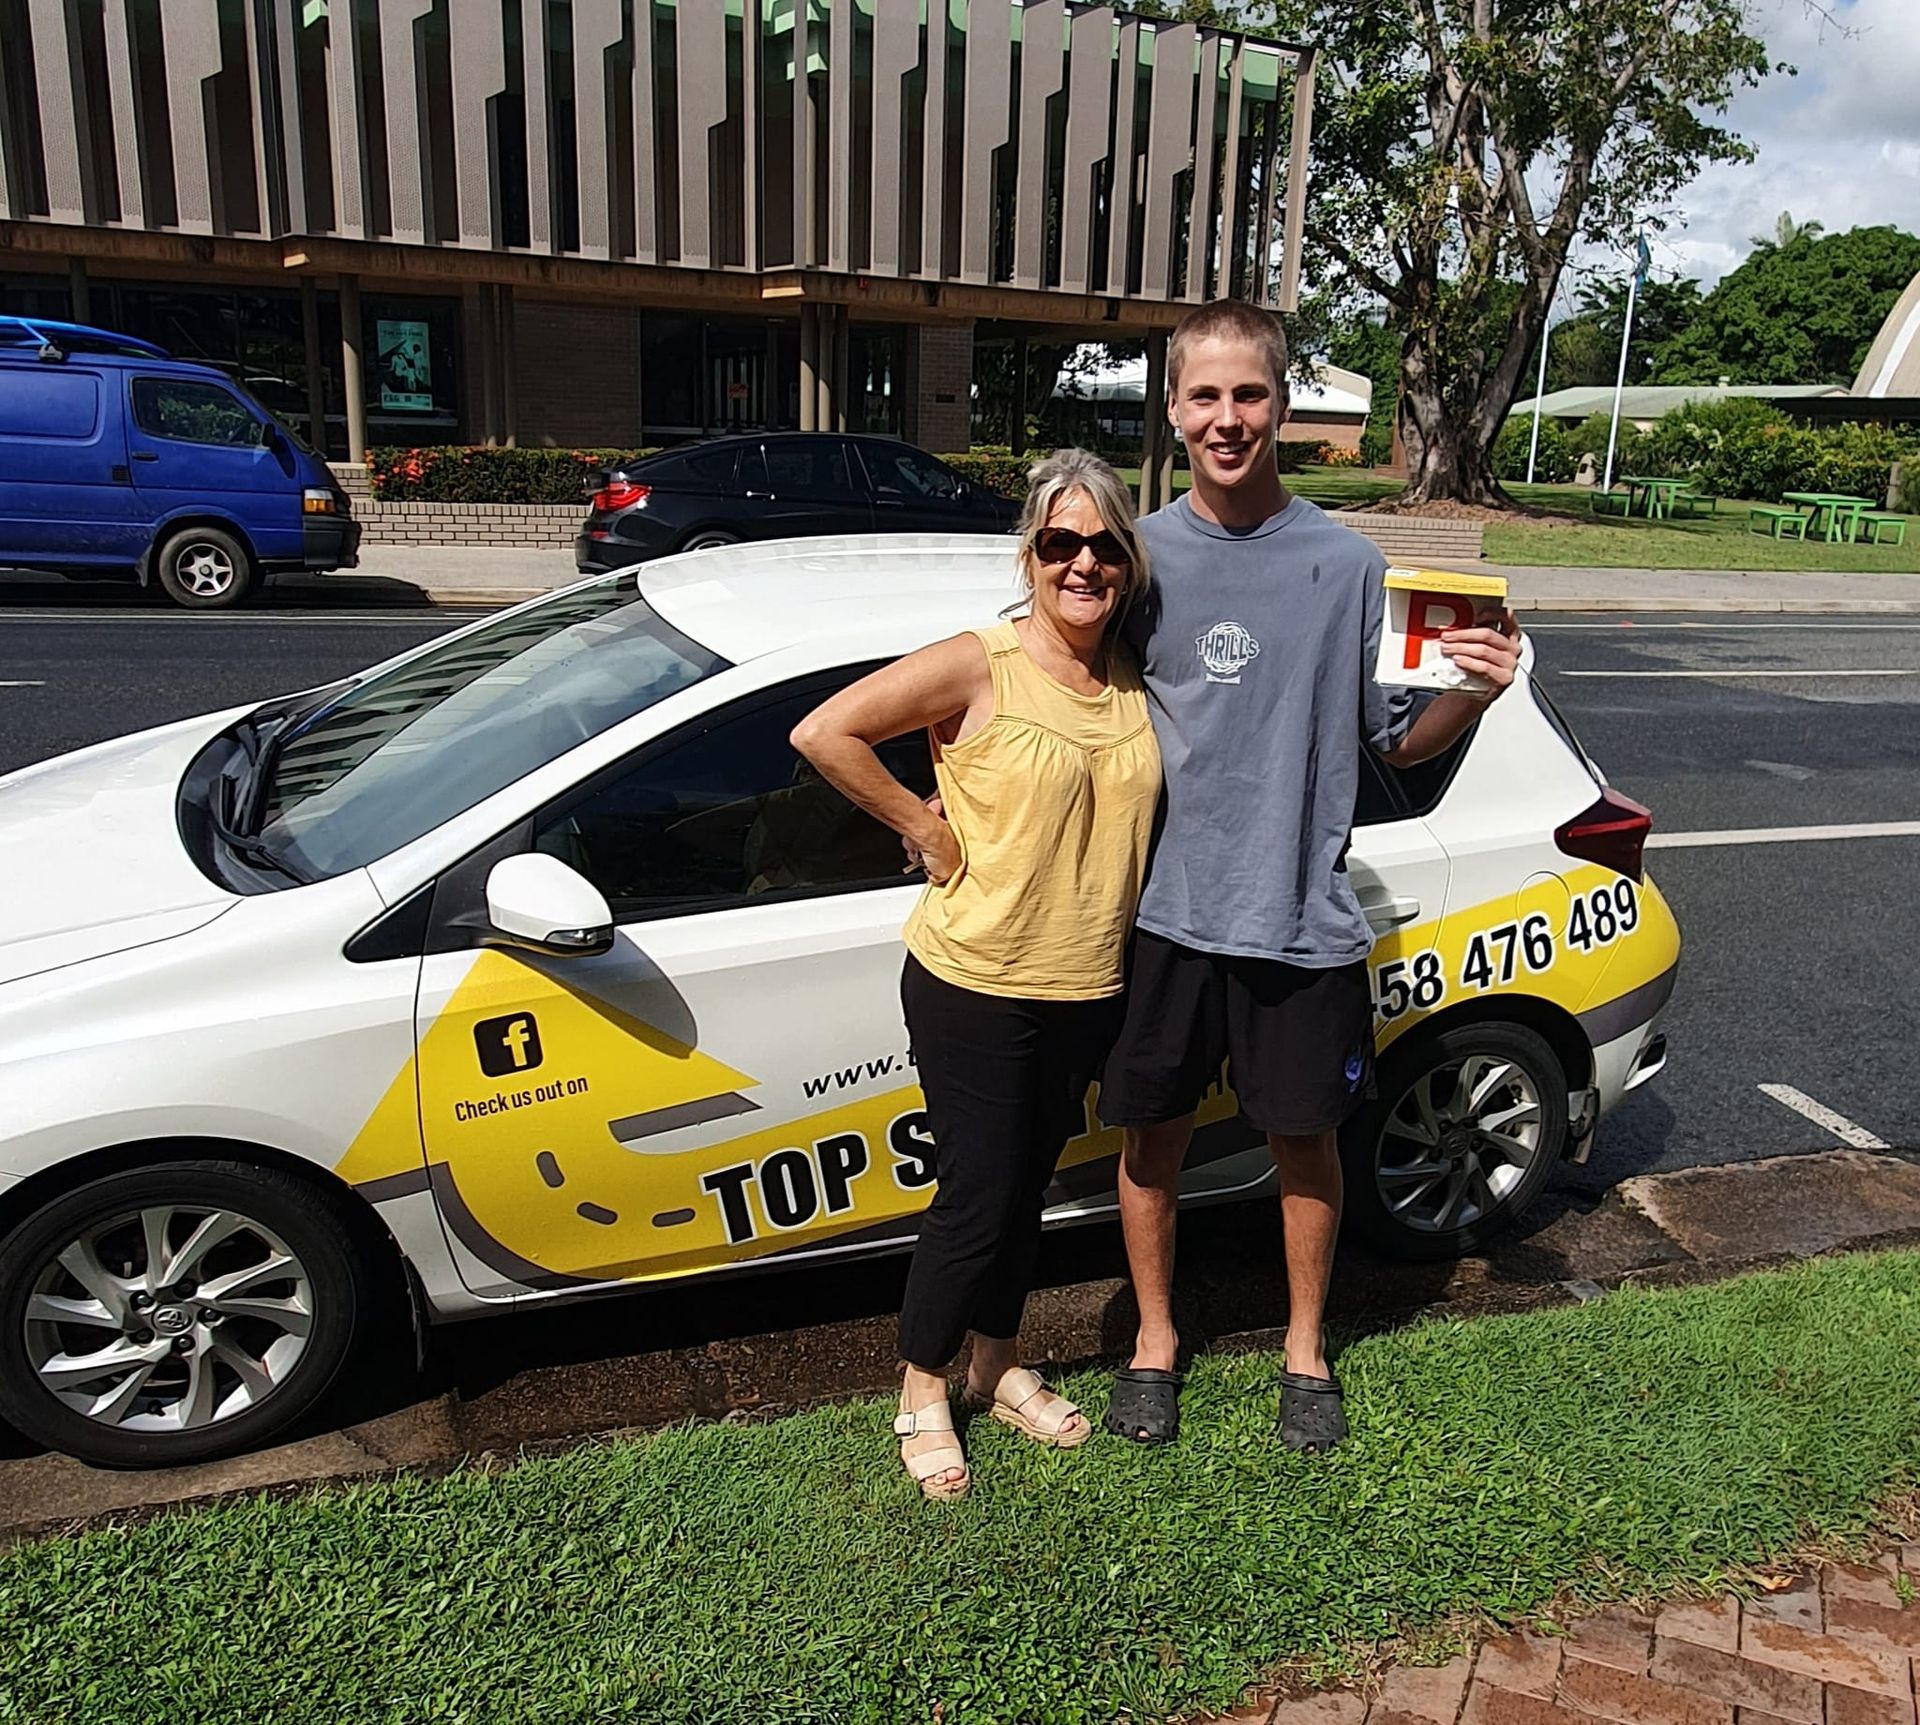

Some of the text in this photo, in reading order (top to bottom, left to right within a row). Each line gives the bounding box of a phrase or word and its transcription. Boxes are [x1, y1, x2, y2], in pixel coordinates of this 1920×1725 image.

[1196, 633, 1259, 662] THRILLS
[1402, 589, 1476, 670] P
[1371, 878, 1638, 1018] 58 476 489
[454, 1076, 589, 1122] Check us out on
[702, 1132, 869, 1244] TOP
